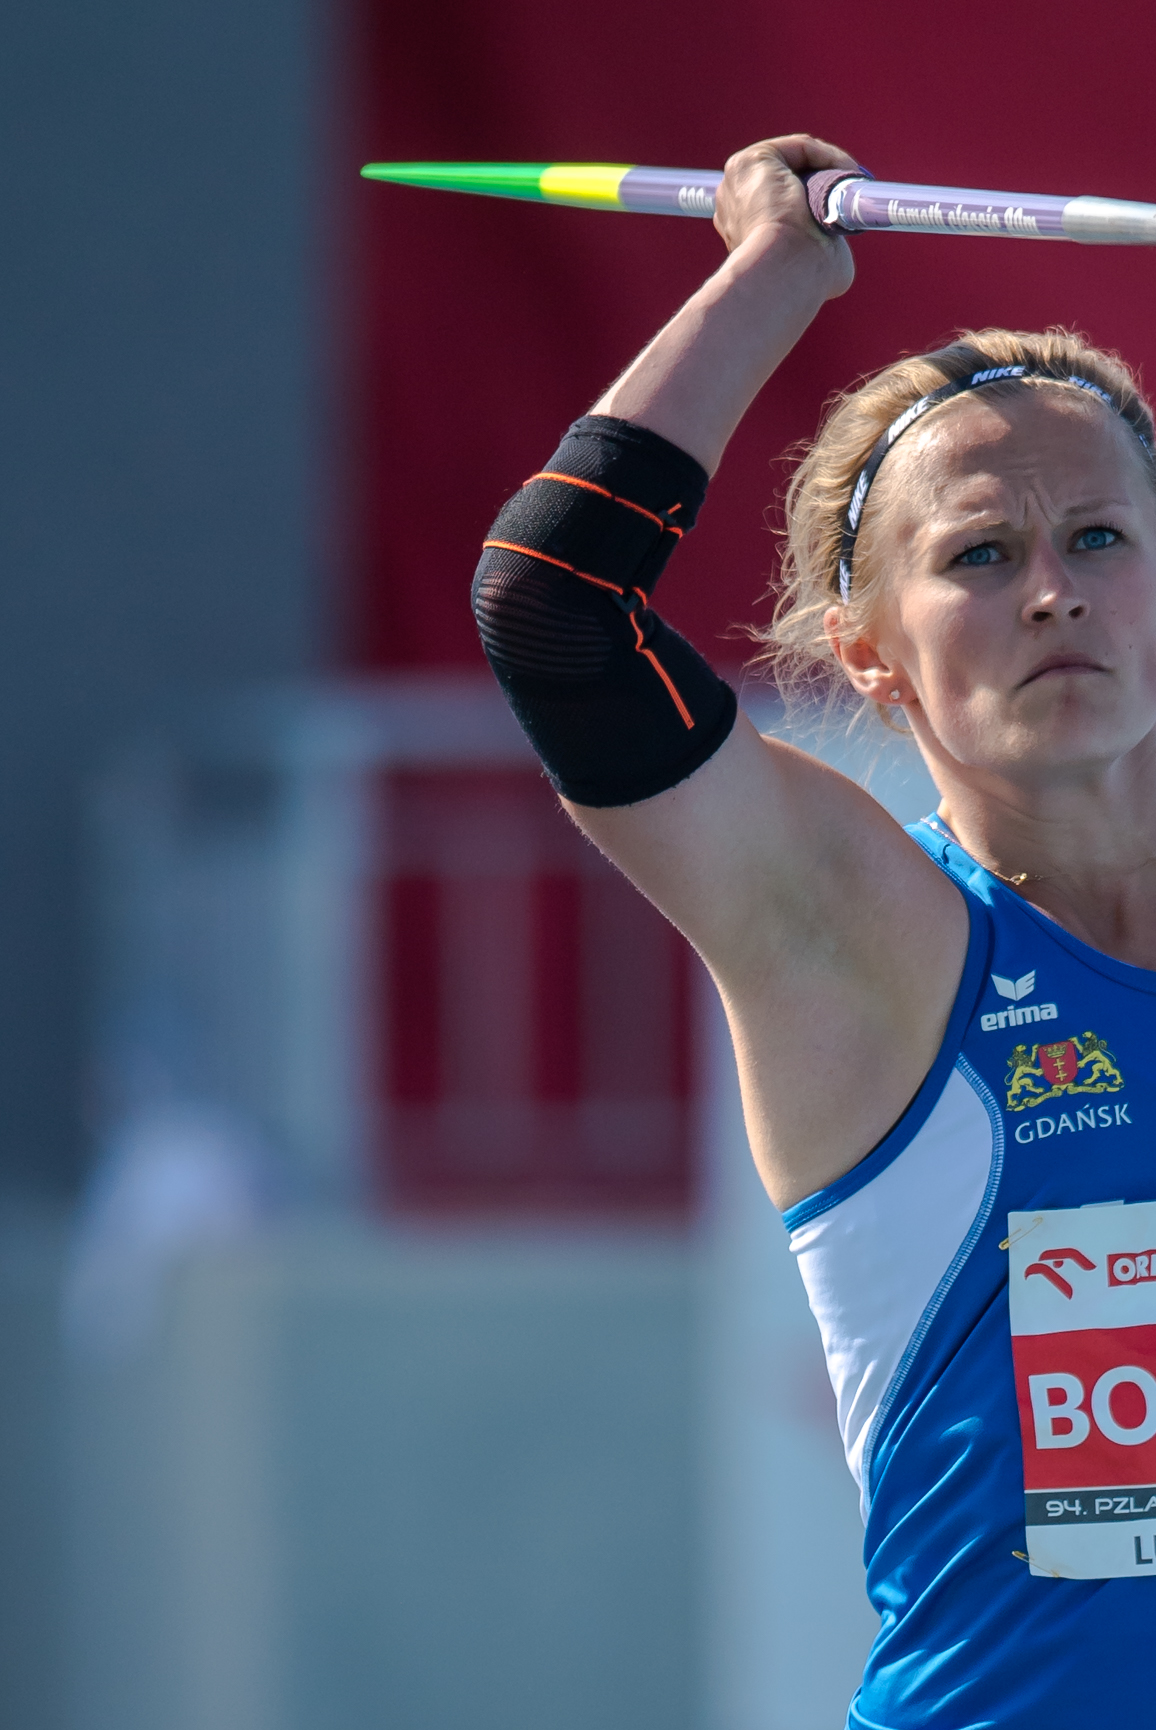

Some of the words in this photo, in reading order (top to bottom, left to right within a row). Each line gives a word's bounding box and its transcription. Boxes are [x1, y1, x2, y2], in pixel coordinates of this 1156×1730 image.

[971, 365, 1026, 386] NIKE
[888, 395, 930, 445] NIKE
[847, 469, 870, 530] NIKE
[980, 1003, 1059, 1032] erima
[1014, 1103, 1133, 1144] GDAŃSK
[1046, 1498, 1088, 1517] 94.
